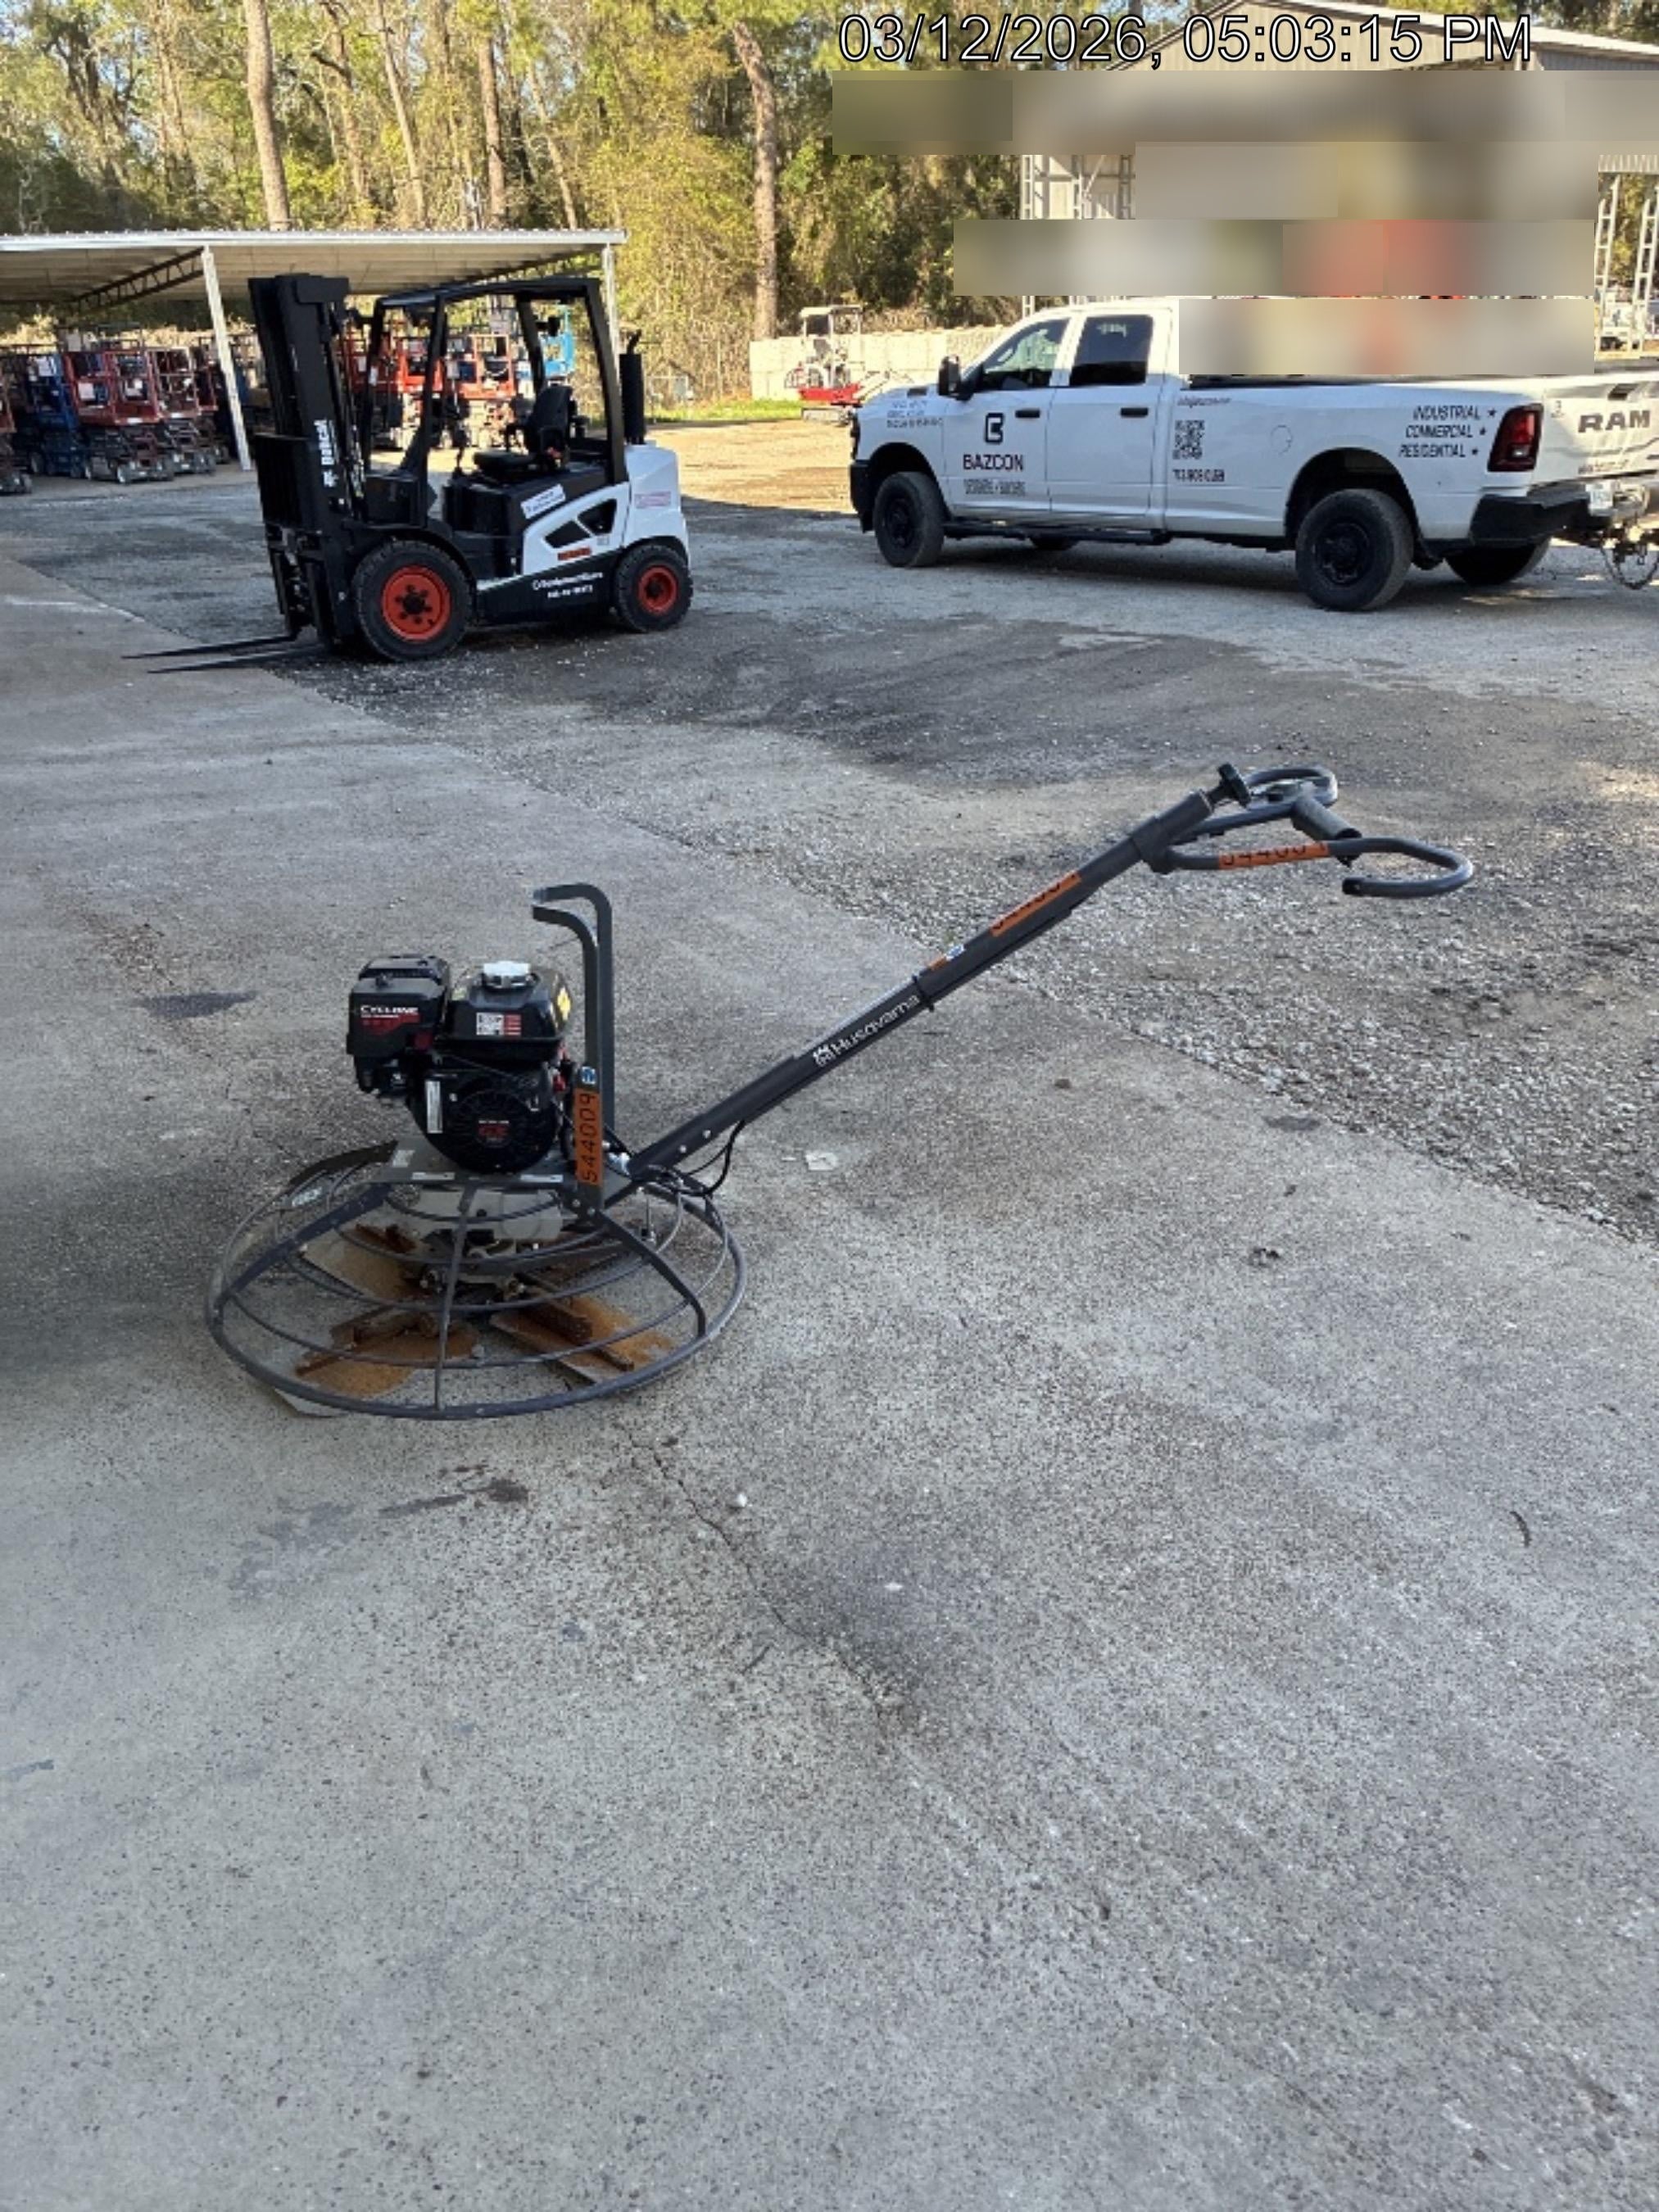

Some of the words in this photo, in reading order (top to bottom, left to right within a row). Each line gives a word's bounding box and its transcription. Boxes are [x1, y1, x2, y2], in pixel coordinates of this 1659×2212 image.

[1412, 405, 1481, 420] INDUSTRIAL
[1577, 410, 1651, 433] RAM
[1405, 424, 1473, 438] COMMERCIAL
[1398, 443, 1466, 458] RESIDENTIAL
[963, 454, 1024, 471] BAZCON
[578, 1093, 598, 1183] 544009
